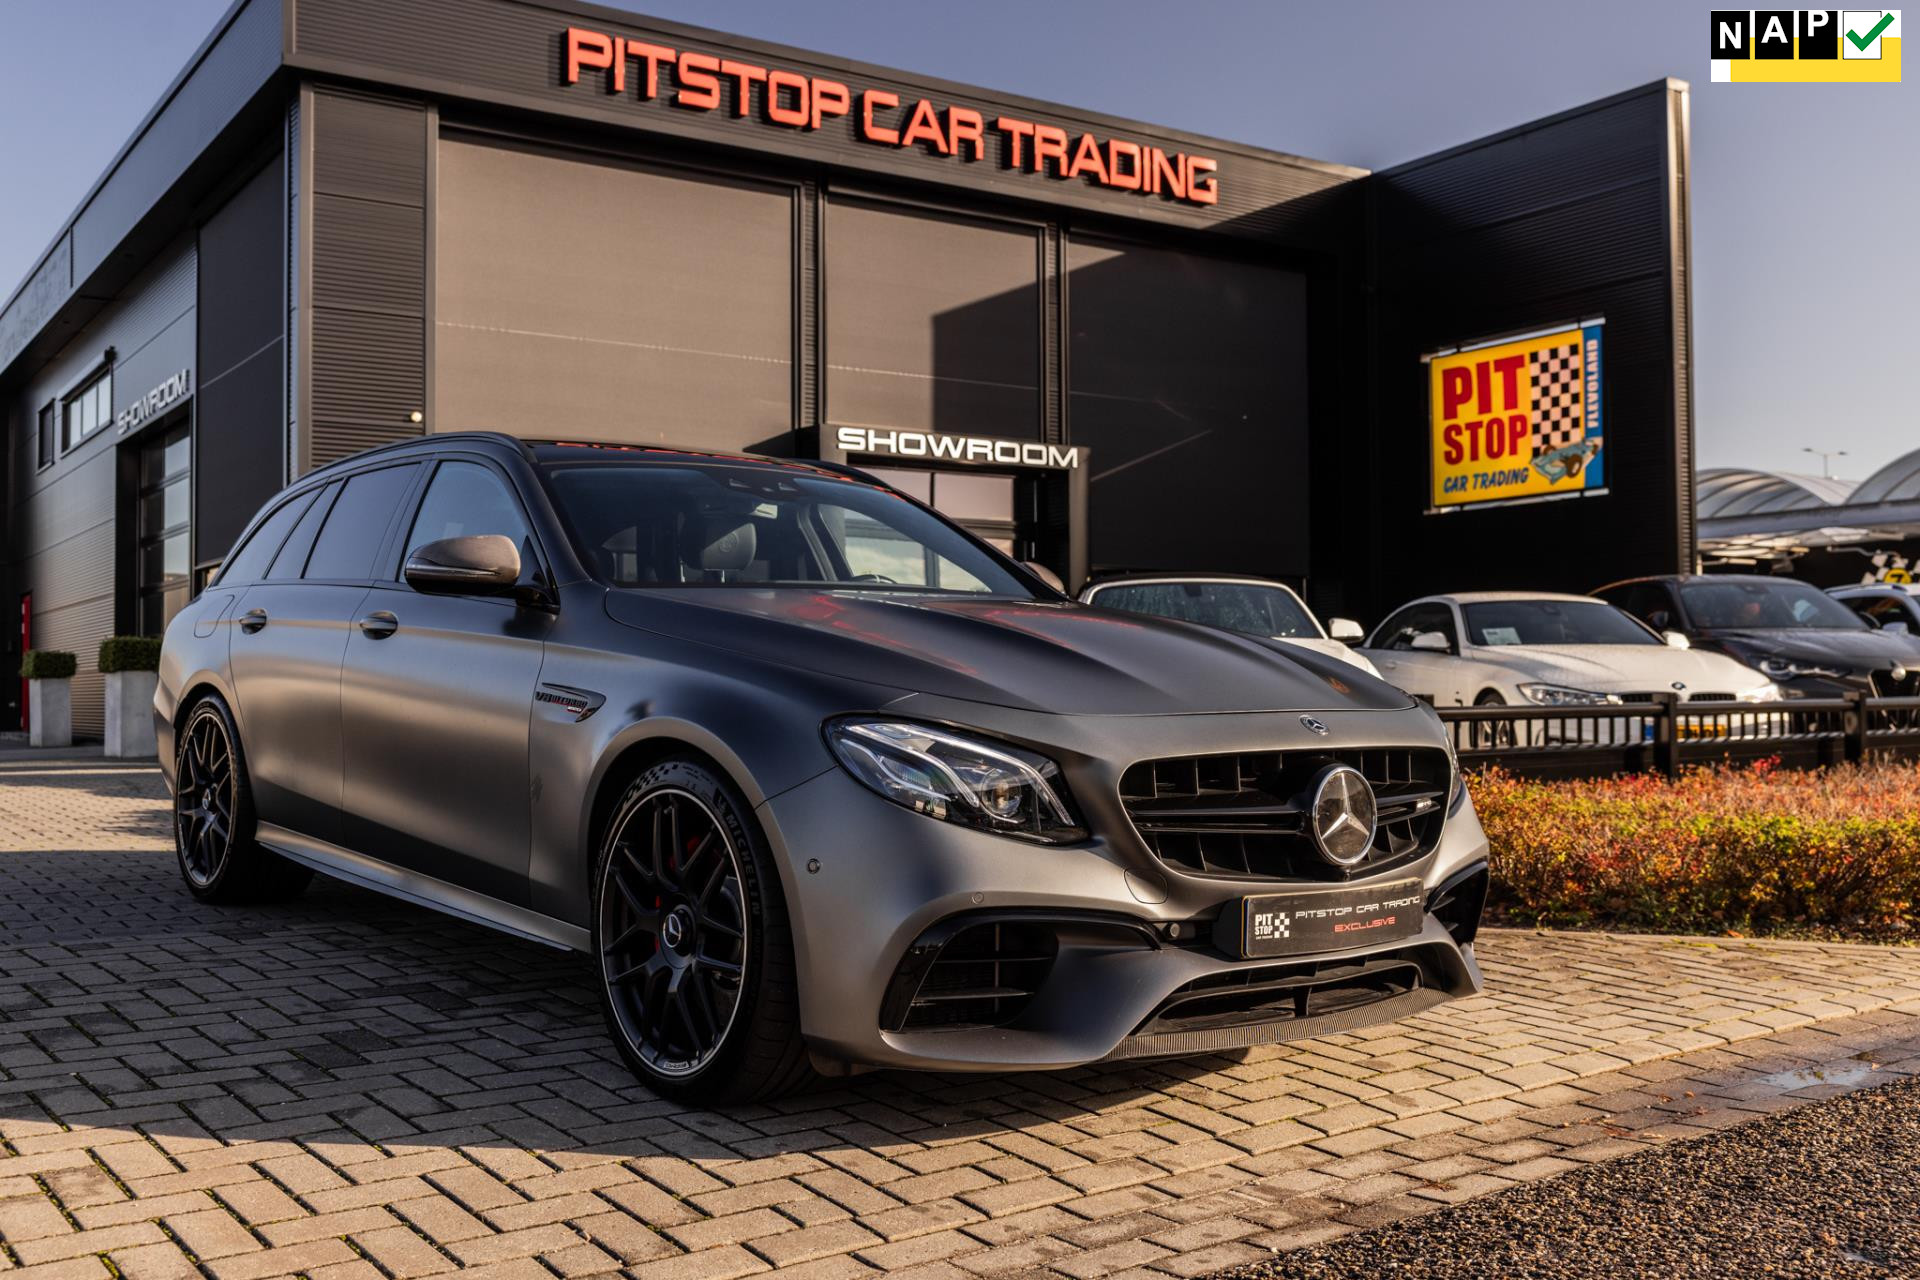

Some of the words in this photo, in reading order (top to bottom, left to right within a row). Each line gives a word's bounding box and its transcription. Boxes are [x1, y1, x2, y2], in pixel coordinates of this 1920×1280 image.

[567, 27, 850, 129] PITSTOP
[863, 89, 984, 161] CAR
[997, 116, 1217, 204] TRADING
[117, 369, 190, 435] SHOWROOM
[1442, 354, 1525, 420] PIT
[1586, 339, 1599, 429] FLEVOLAND
[837, 427, 1078, 468] SHOWROOM
[1443, 414, 1528, 466] STOP
[1443, 475, 1468, 493] CAR
[1473, 467, 1529, 490] TRADING
[725, 814, 761, 916] MICHELIN
[1255, 913, 1273, 926] PIT
[1295, 907, 1352, 919] PITSTOP
[1356, 903, 1379, 913] CAR
[1382, 895, 1420, 909] TRADING
[1334, 916, 1396, 932] EXCLUSIVE
[1255, 925, 1273, 936] STOP
